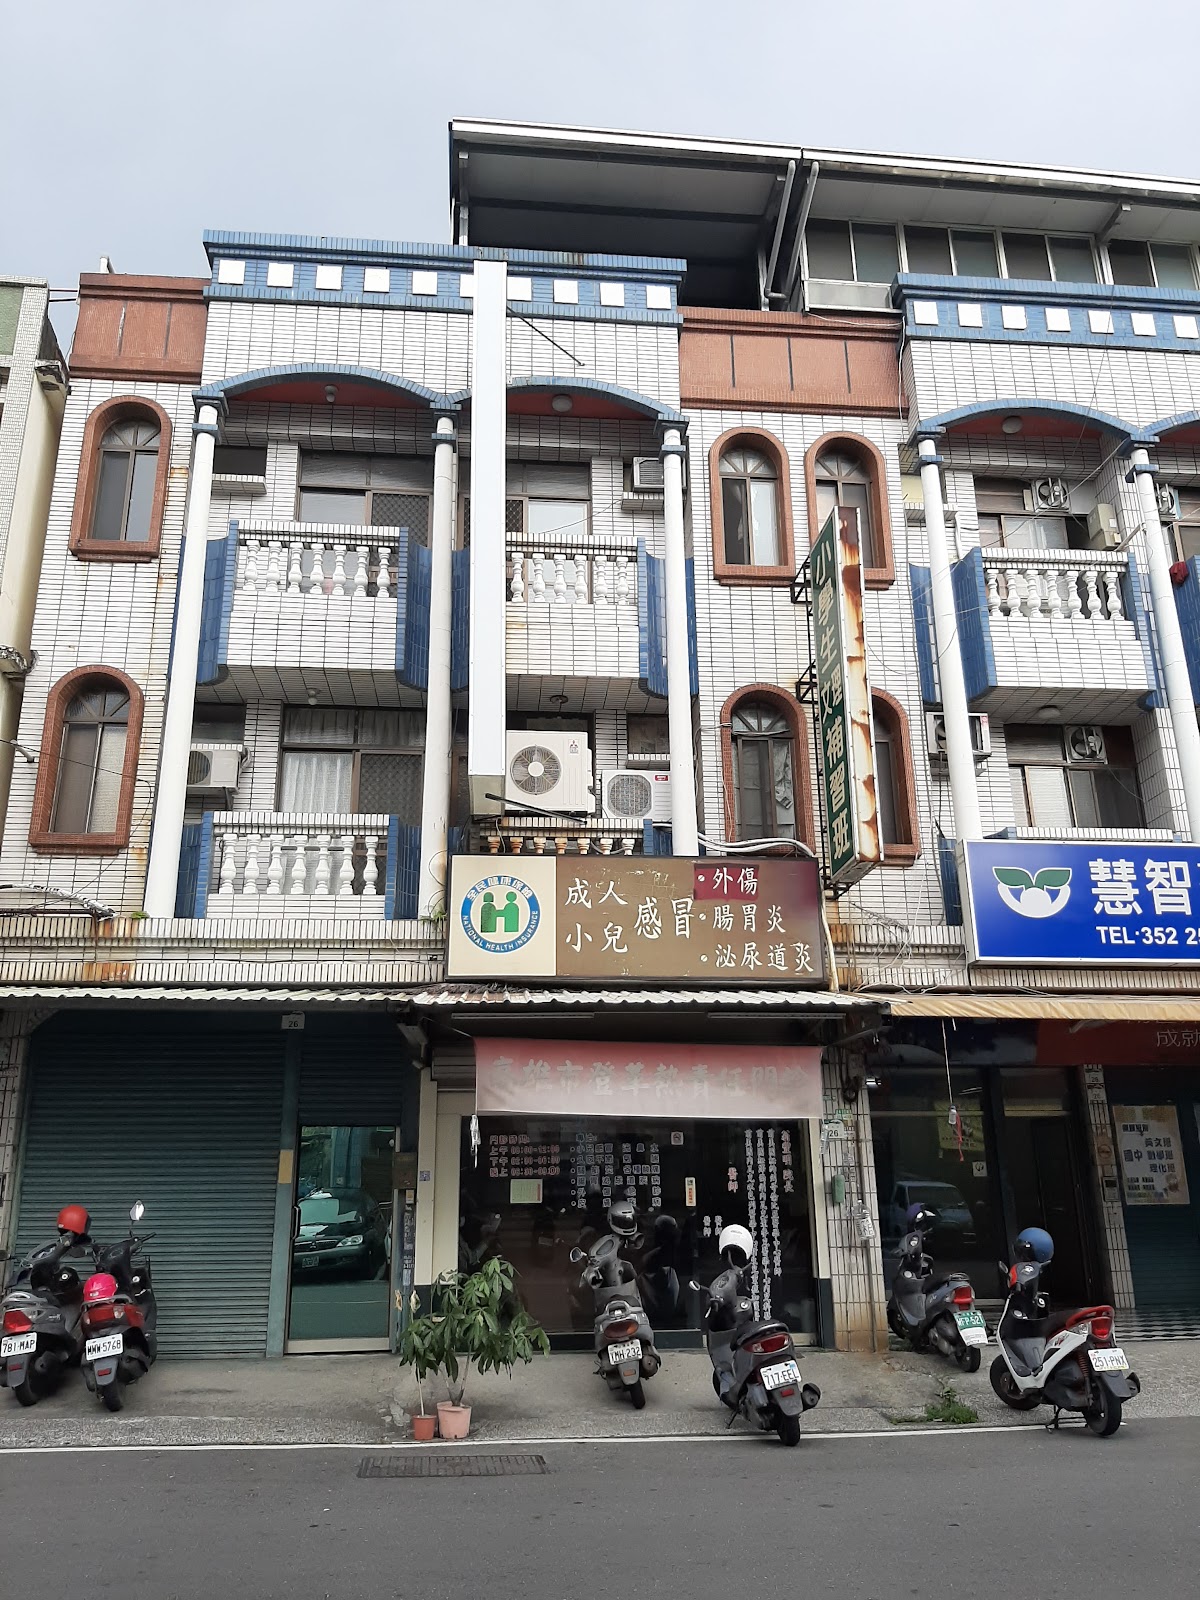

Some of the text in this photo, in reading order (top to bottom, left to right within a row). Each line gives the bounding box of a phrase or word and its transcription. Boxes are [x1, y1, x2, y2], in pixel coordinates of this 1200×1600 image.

[565, 877, 629, 909] 成人
[712, 867, 758, 895] 外傷
[1088, 858, 1200, 916] 慧智
[462, 910, 539, 951] NATIONAL HEALTH INSURANCE
[634, 896, 695, 940] 感冒
[712, 903, 786, 934] 腸胃炎
[565, 922, 628, 954] 小兒
[1184, 927, 1200, 945] 2
[714, 941, 814, 974] 泌尿道炎
[829, 1129, 839, 1137] 26
